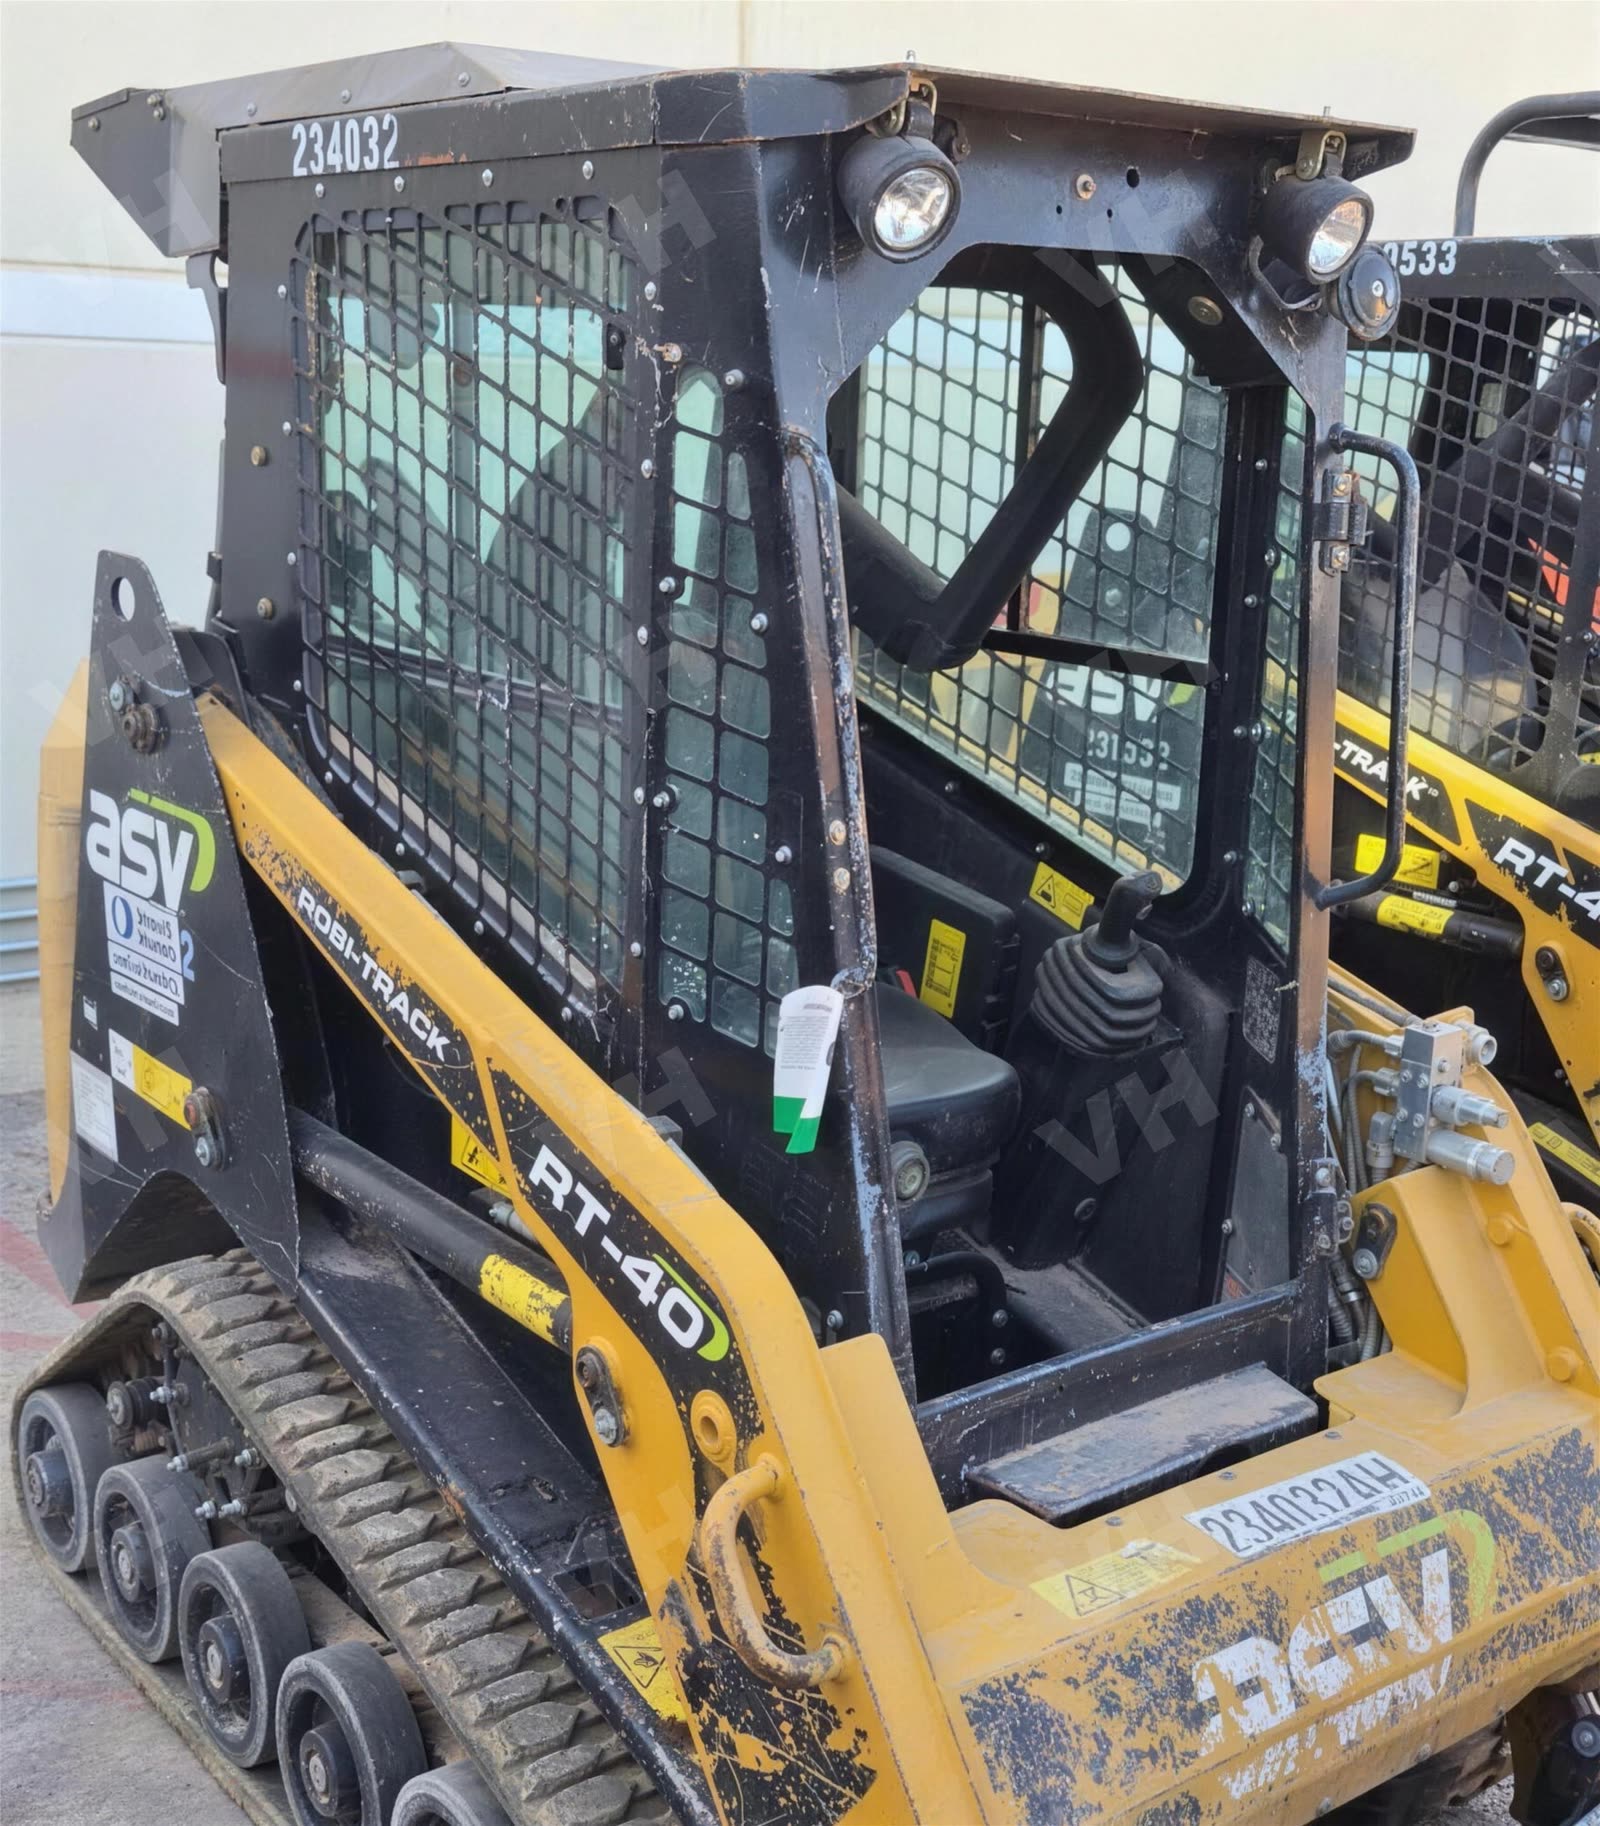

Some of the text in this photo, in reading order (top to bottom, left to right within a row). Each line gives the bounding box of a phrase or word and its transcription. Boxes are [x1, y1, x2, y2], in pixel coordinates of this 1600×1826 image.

[292, 113, 400, 177] 234032
[297, 886, 450, 1062] ROBI-TRACK
[528, 1144, 704, 1349] RT-40
